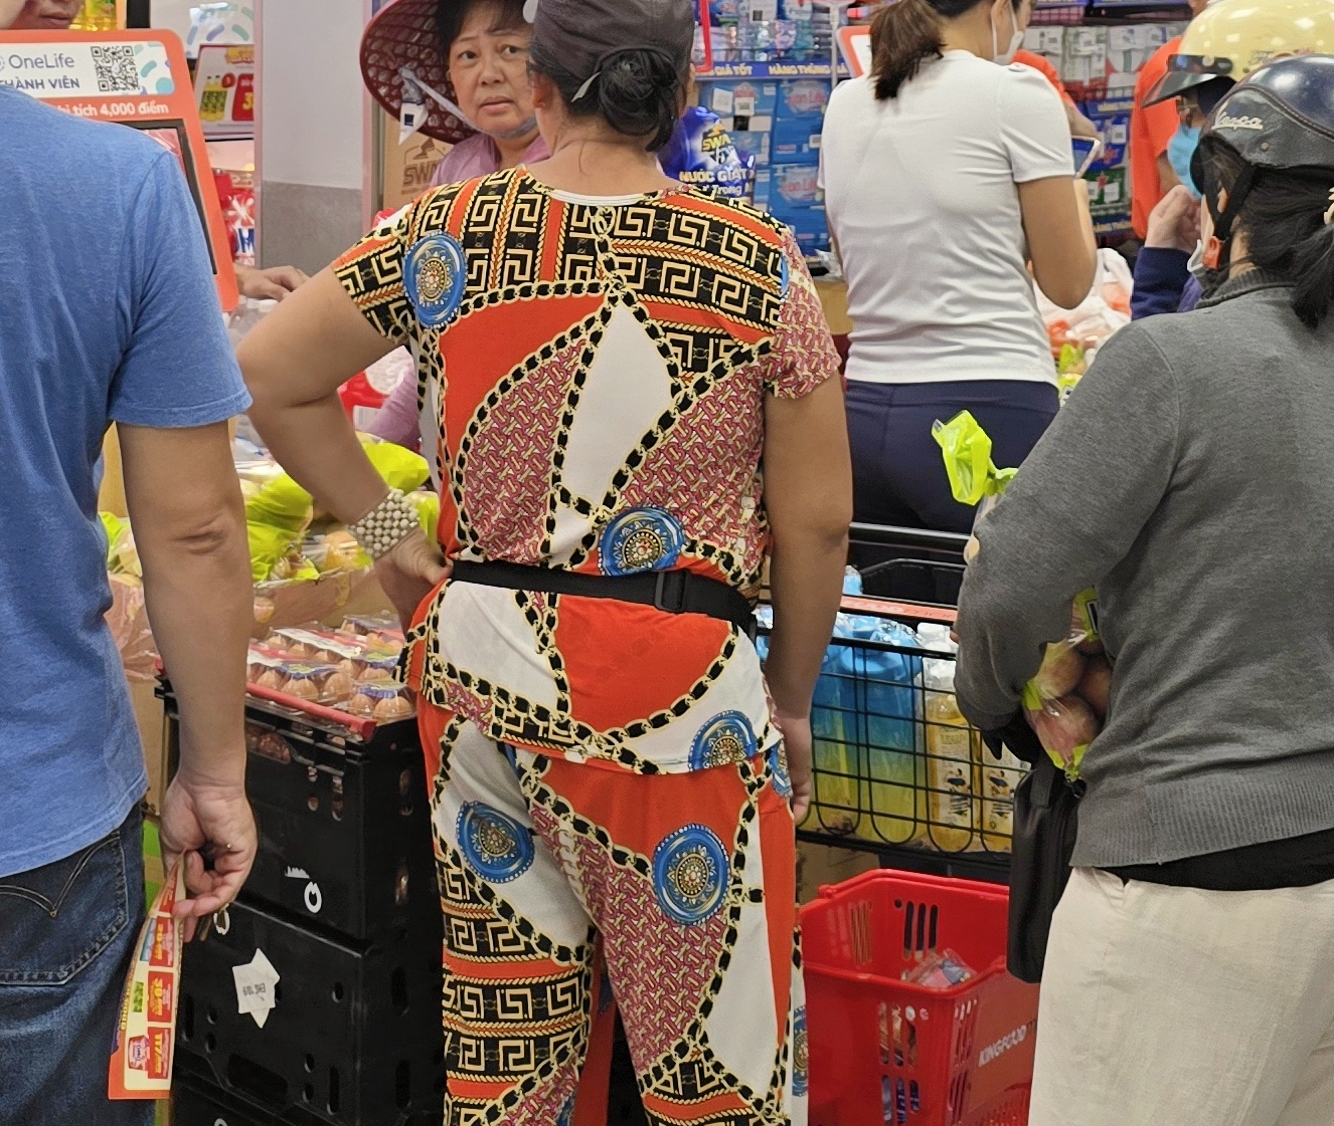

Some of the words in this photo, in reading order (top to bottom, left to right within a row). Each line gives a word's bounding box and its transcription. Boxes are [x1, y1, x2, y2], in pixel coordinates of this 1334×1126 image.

[8, 52, 75, 70] OneLife
[50, 74, 81, 90] VIÊN
[99, 102, 136, 116] 4,000
[138, 99, 170, 116] điểm
